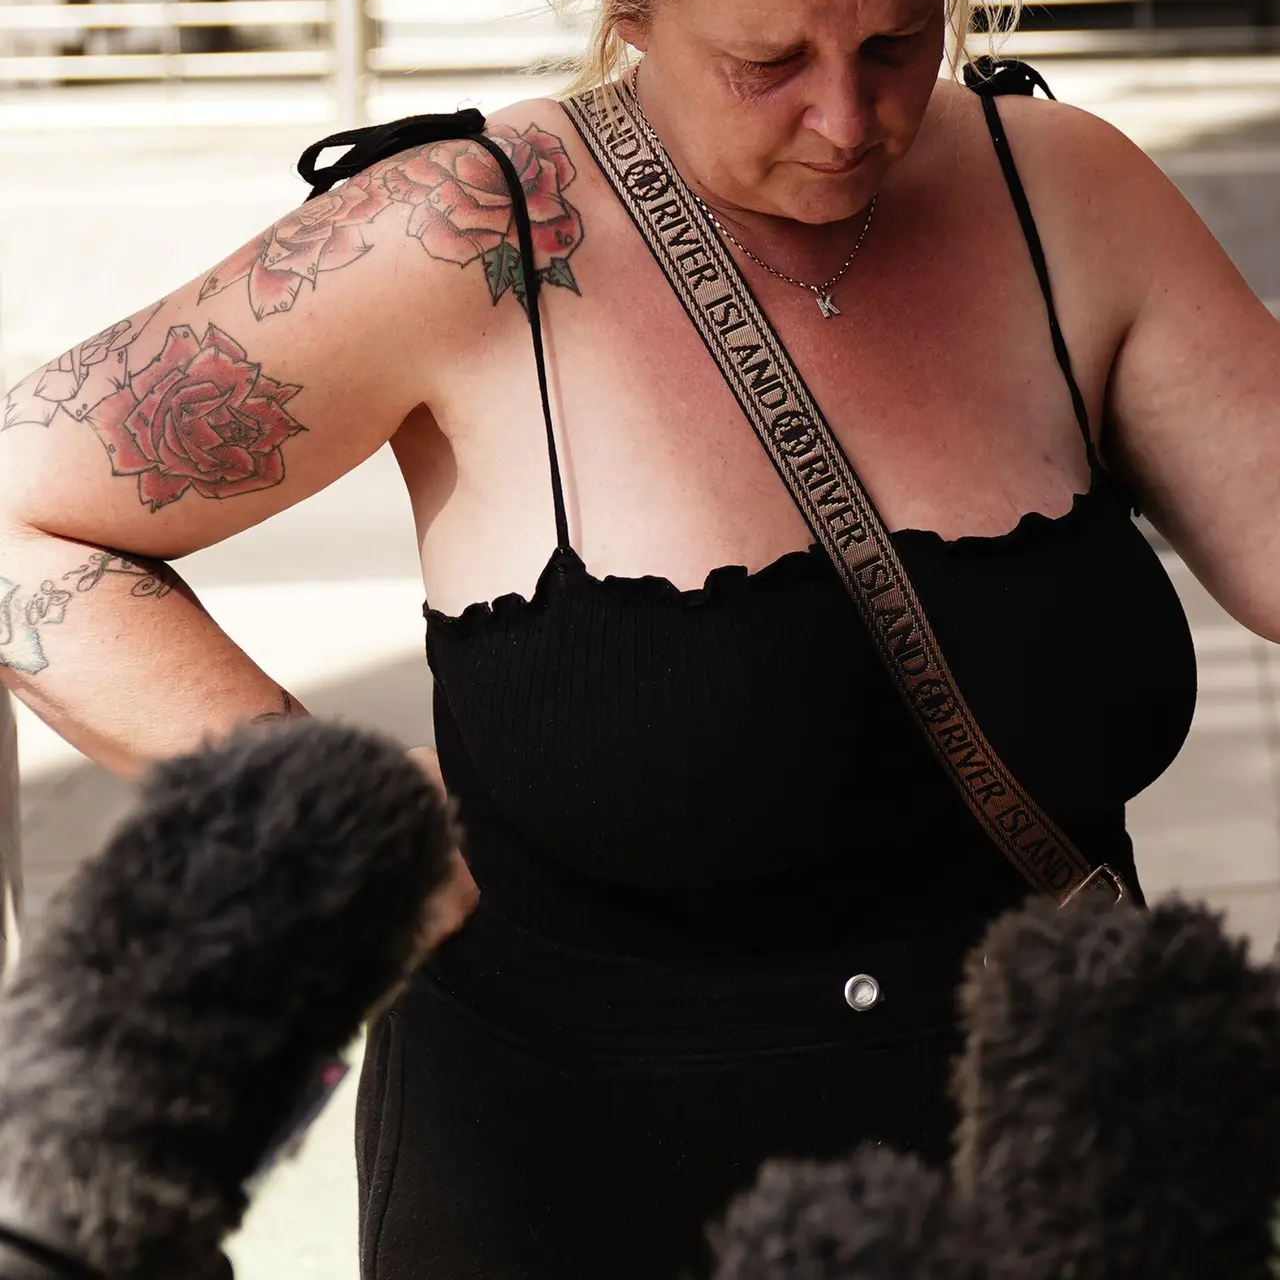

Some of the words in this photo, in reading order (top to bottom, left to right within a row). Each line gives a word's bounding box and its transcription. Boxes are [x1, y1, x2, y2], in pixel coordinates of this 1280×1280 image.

[648, 198, 720, 291] RIVER
[705, 294, 790, 410] ISLAND
[802, 460, 866, 551] RIVER
[852, 552, 930, 678] ISLAND
[936, 721, 1007, 806] RIVER
[994, 803, 1073, 889] ISLAND
